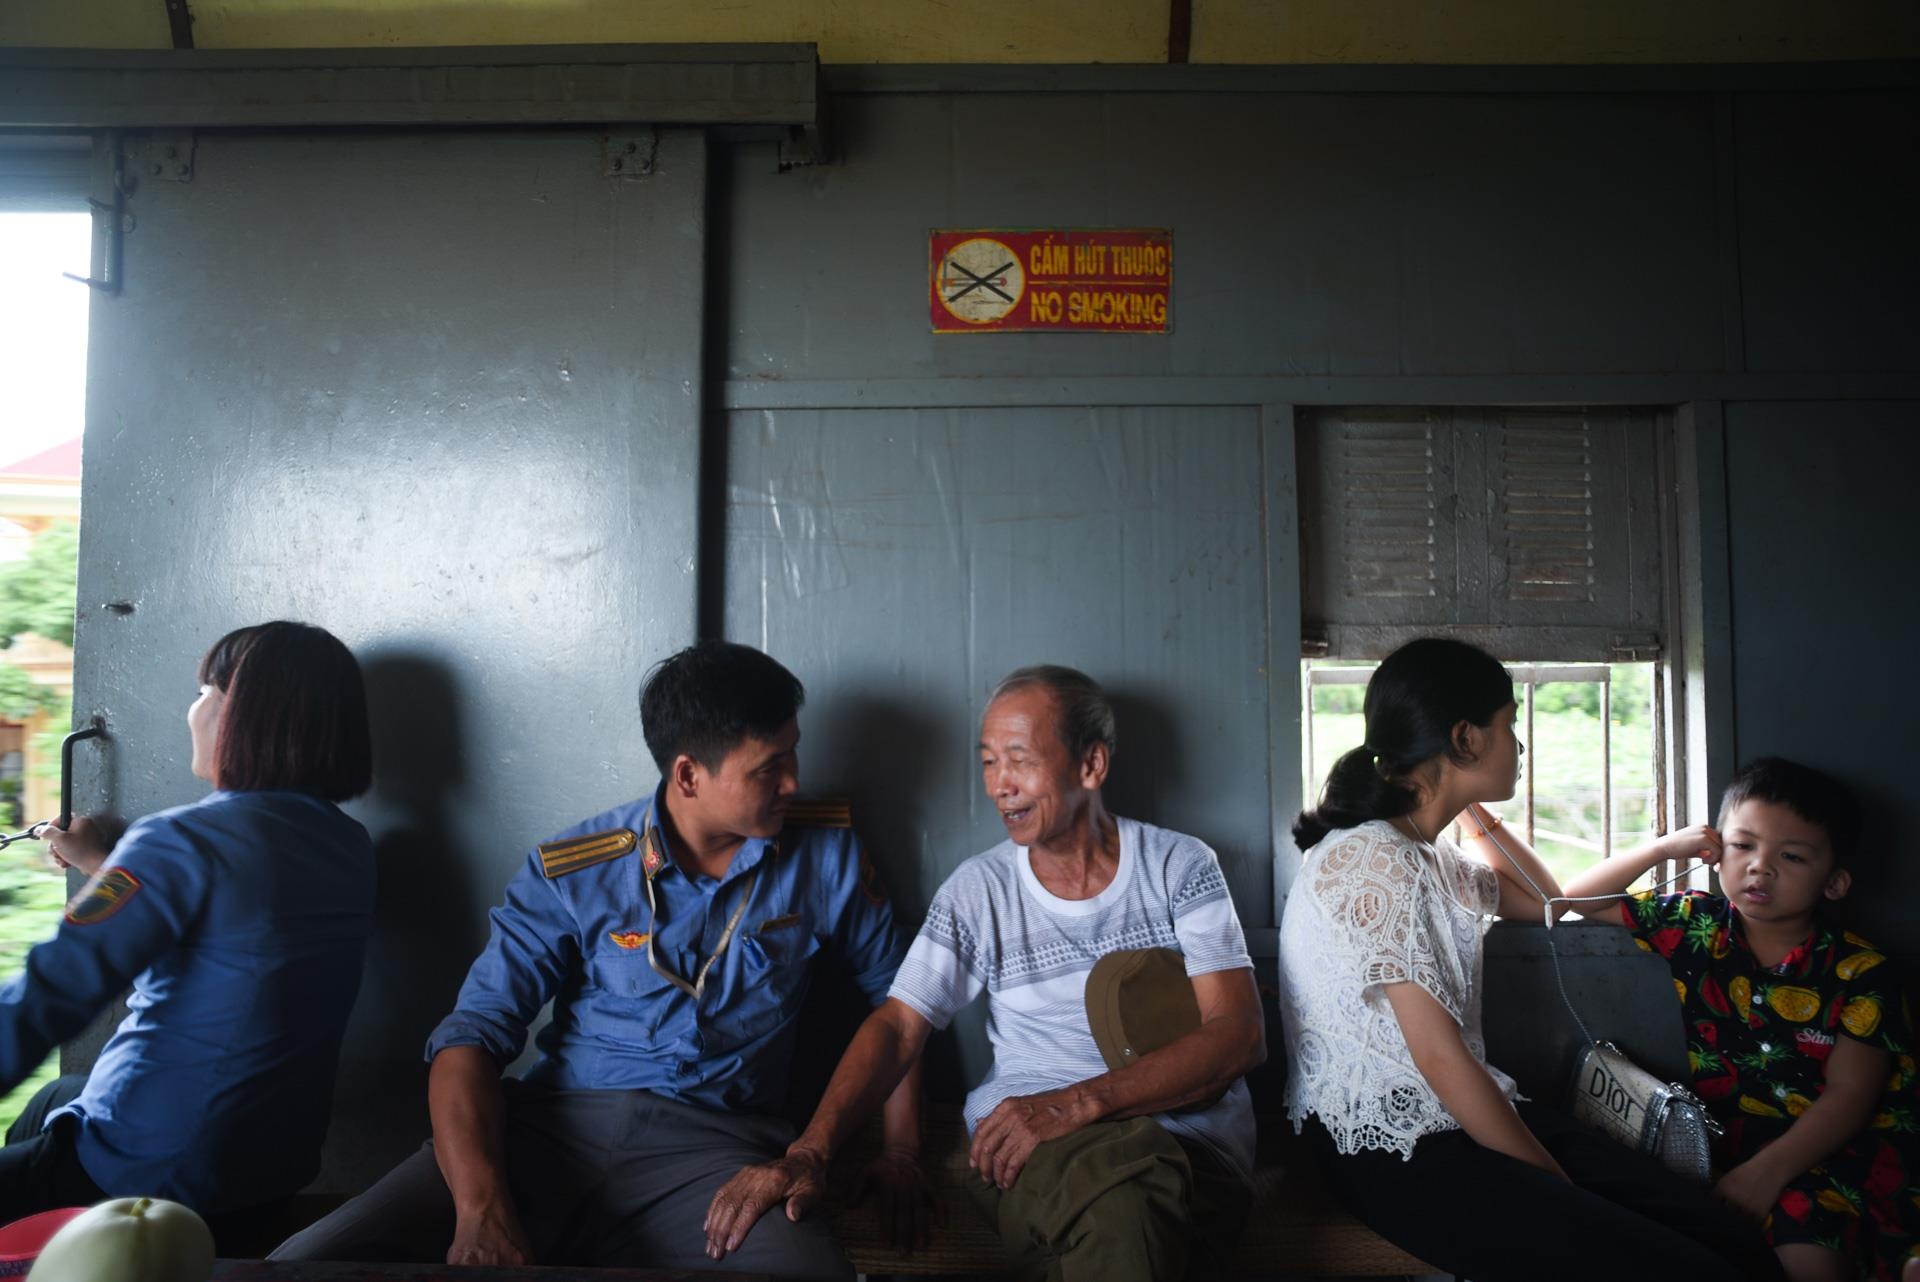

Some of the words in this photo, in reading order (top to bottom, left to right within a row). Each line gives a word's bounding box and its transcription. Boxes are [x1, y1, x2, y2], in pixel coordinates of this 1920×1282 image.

[1030, 234, 1069, 275] CẤM
[1074, 239, 1107, 275] HÚT
[1030, 291, 1063, 323] NO
[1068, 291, 1167, 324] SMOKING
[1590, 1067, 1635, 1120] Dior
